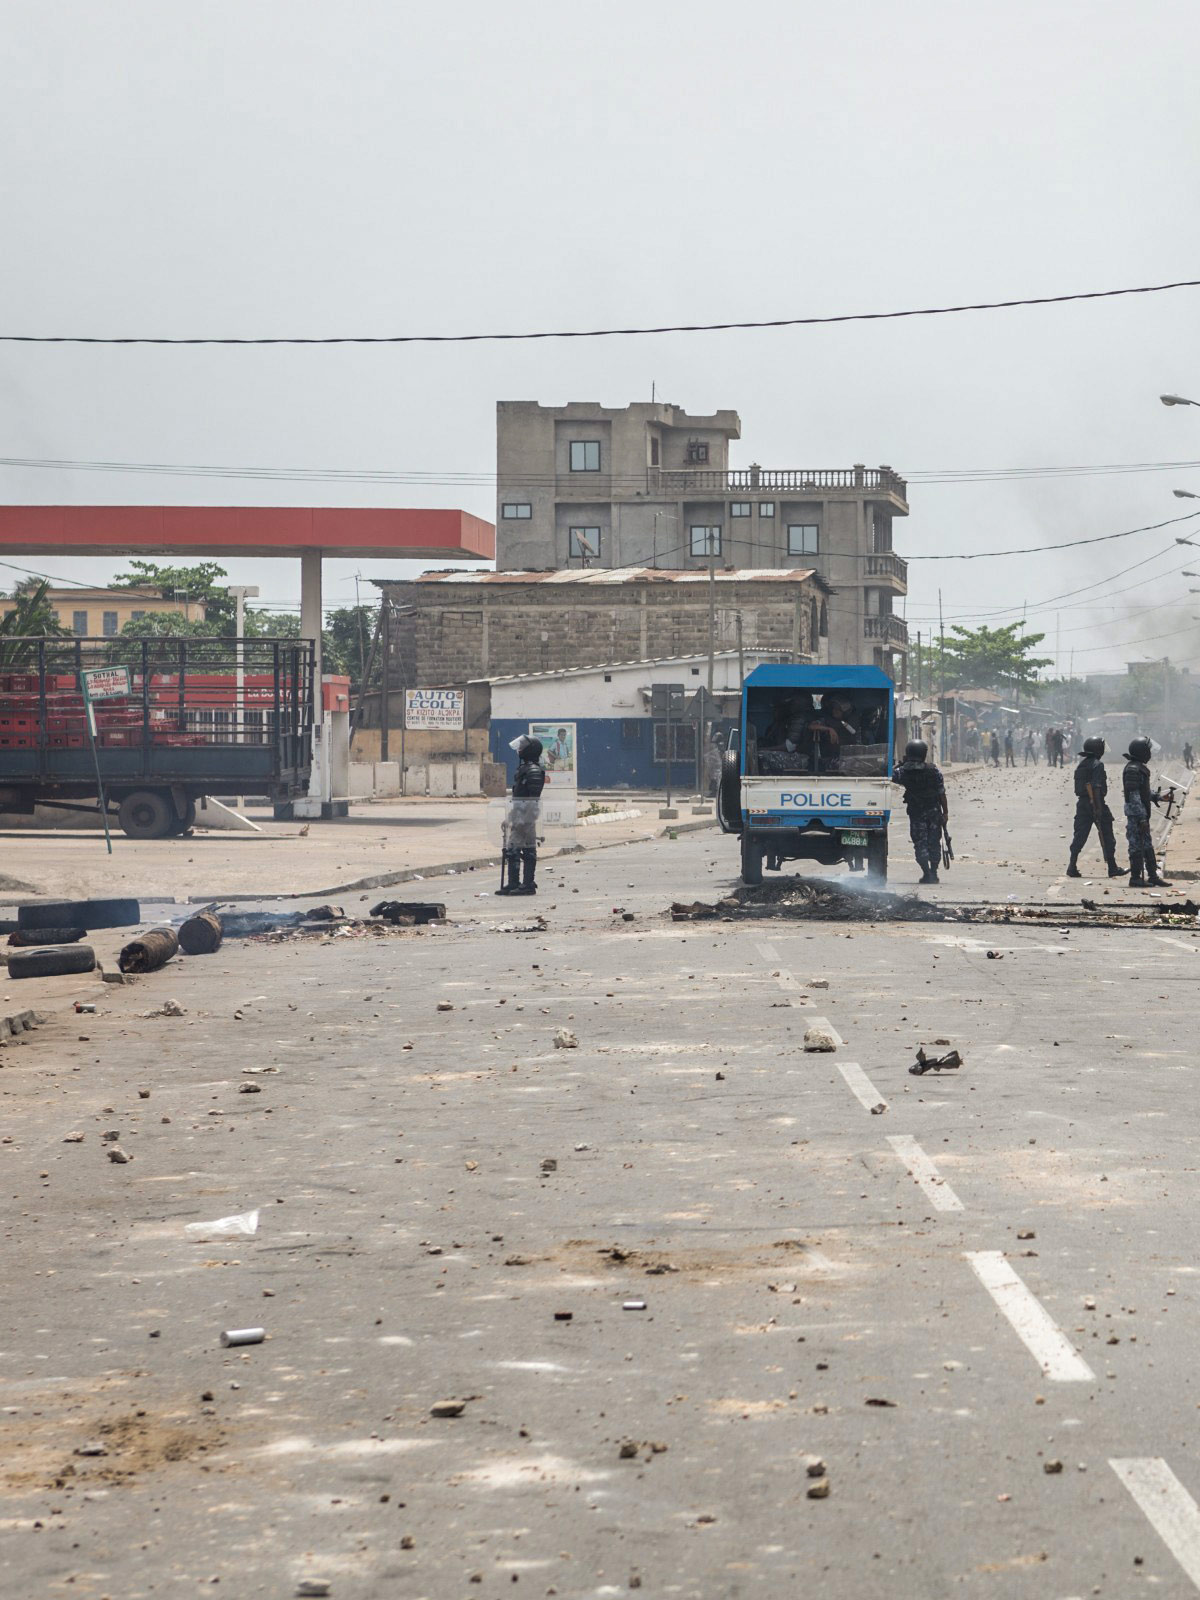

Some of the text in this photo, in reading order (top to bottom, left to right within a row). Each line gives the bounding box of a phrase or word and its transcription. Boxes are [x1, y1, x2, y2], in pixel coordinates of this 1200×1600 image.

[415, 691, 456, 700] AUTO
[409, 700, 461, 709] ECOLE
[781, 793, 851, 807] POLICE
